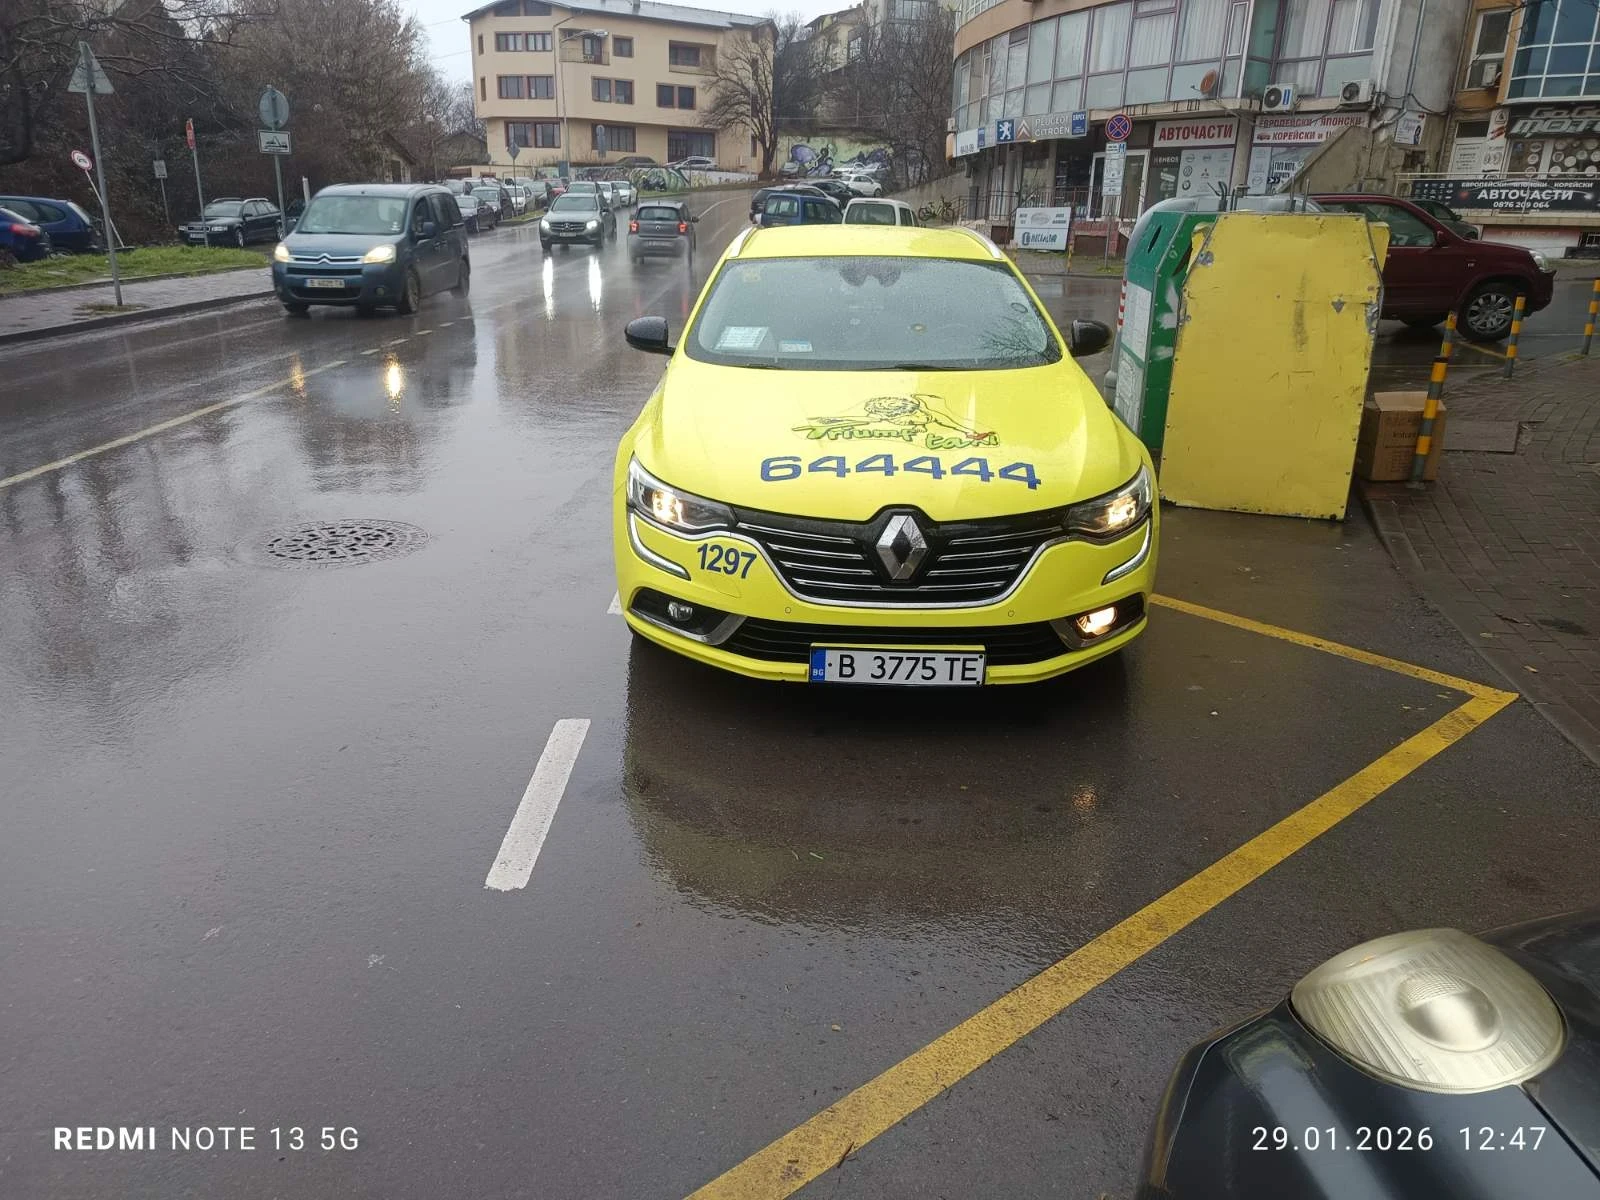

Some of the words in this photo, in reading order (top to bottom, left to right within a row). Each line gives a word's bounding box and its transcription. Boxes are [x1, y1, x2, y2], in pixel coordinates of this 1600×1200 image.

[1035, 115, 1069, 127] PEUGEOT
[1158, 124, 1234, 141] АВТОЧАСТИ
[1272, 131, 1316, 140] КОРЕЙСКИ
[1477, 189, 1574, 200] АВТОЧАСТИ
[792, 421, 918, 442] Triumf
[925, 431, 999, 449] taxi
[760, 454, 1041, 490] 644444
[697, 543, 757, 579] 1297
[812, 668, 824, 676] BG
[838, 654, 856, 678] B
[870, 655, 937, 681] 3775
[945, 657, 979, 682] TE
